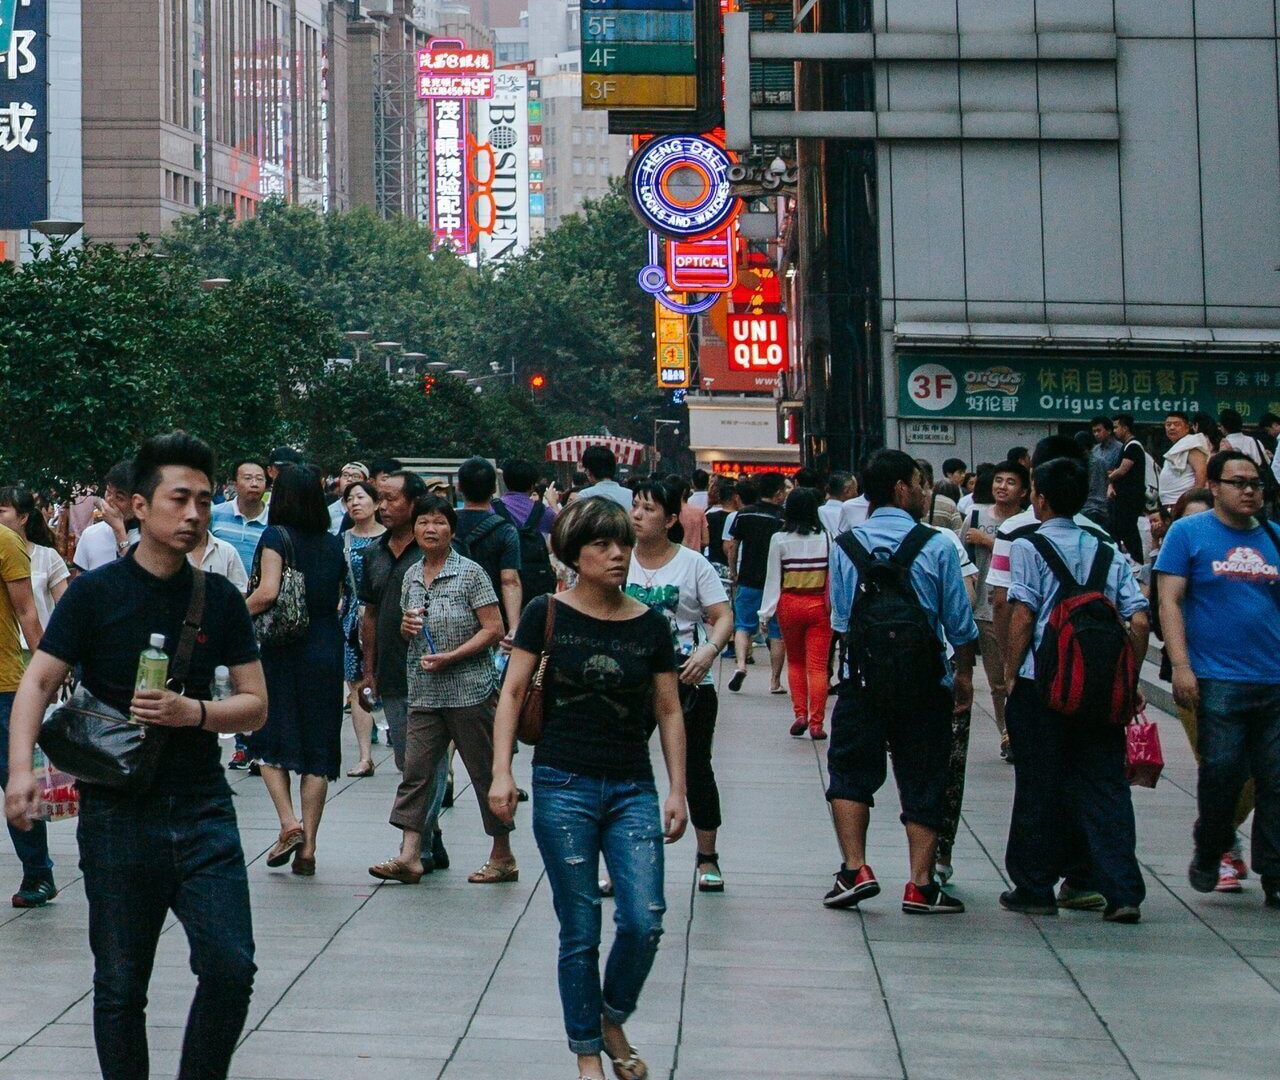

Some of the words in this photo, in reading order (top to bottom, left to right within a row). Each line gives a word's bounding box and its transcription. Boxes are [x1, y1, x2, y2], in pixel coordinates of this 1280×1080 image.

[589, 16, 615, 35] 5F
[589, 49, 616, 67] 4F
[472, 78, 490, 95] 9F
[589, 80, 616, 99] 3F
[642, 140, 682, 173] HENG
[690, 141, 727, 172] DALI
[668, 216, 690, 227] AND
[676, 256, 726, 268] OPTICAL
[733, 320, 777, 341] UNI
[734, 344, 782, 368] QLO
[913, 374, 952, 399] 3F
[1038, 369, 1199, 395] 休闲自助西餐厅
[966, 396, 1019, 412] 好伦哥
[1040, 395, 1104, 414] Origus
[1109, 396, 1200, 412] Cafeteria
